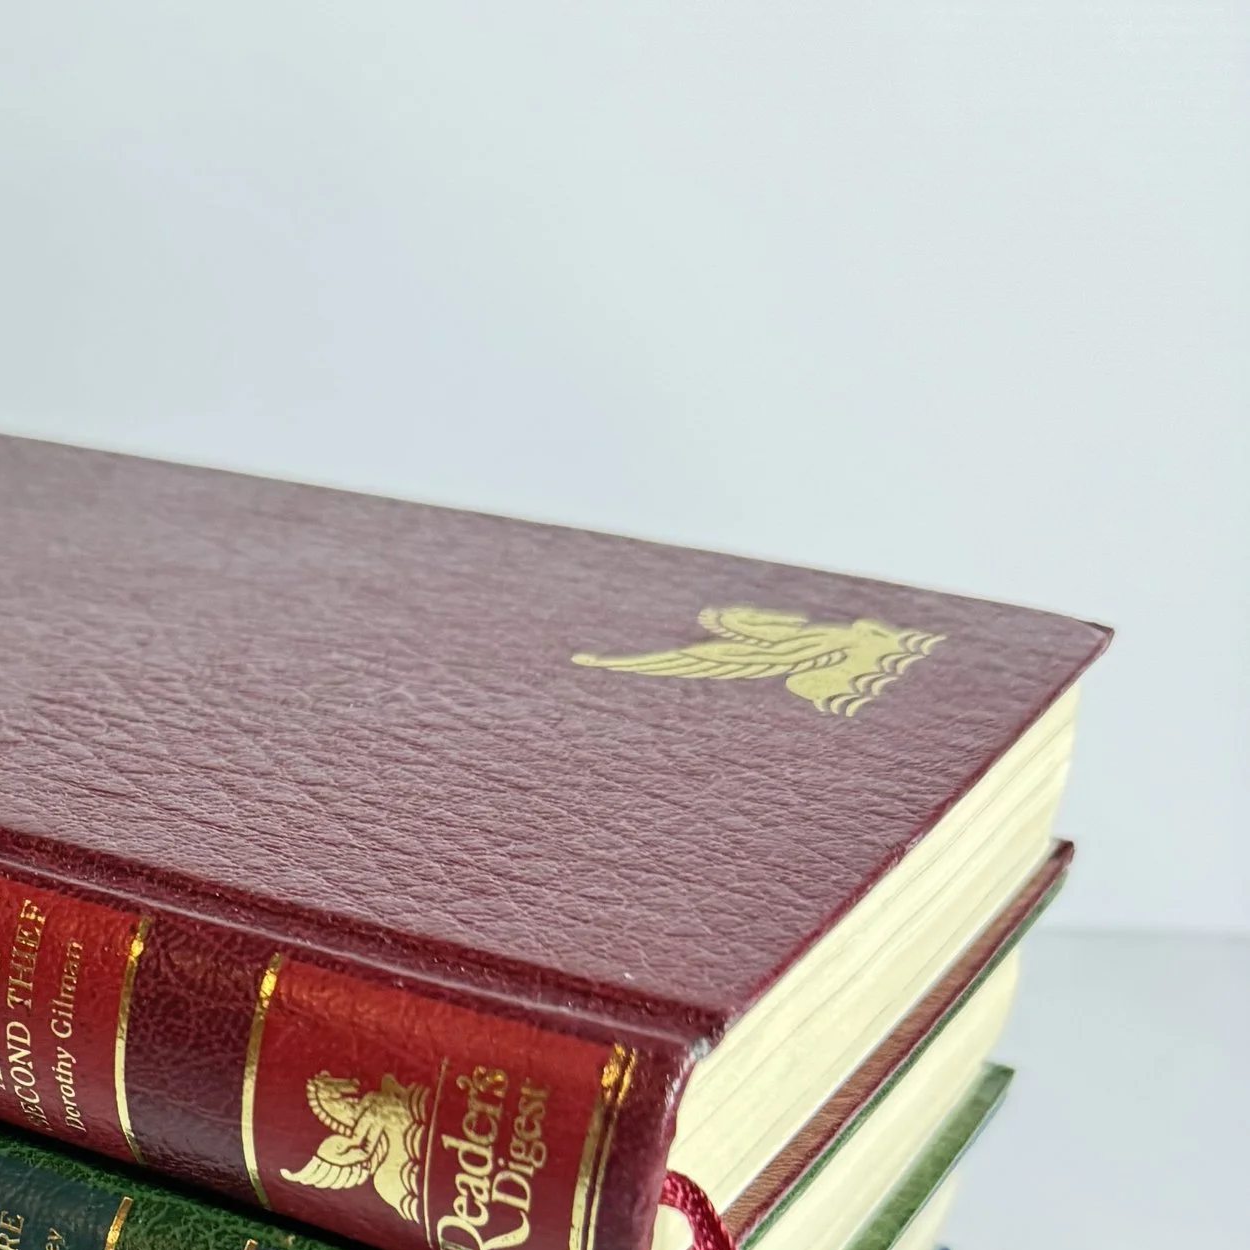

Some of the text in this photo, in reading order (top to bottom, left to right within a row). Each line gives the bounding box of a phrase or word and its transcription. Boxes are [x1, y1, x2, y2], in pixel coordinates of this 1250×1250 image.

[6, 899, 52, 1131] SECOND THIEF
[51, 939, 87, 1132] Dorothy Gilman
[491, 1077, 548, 1213] Digest
